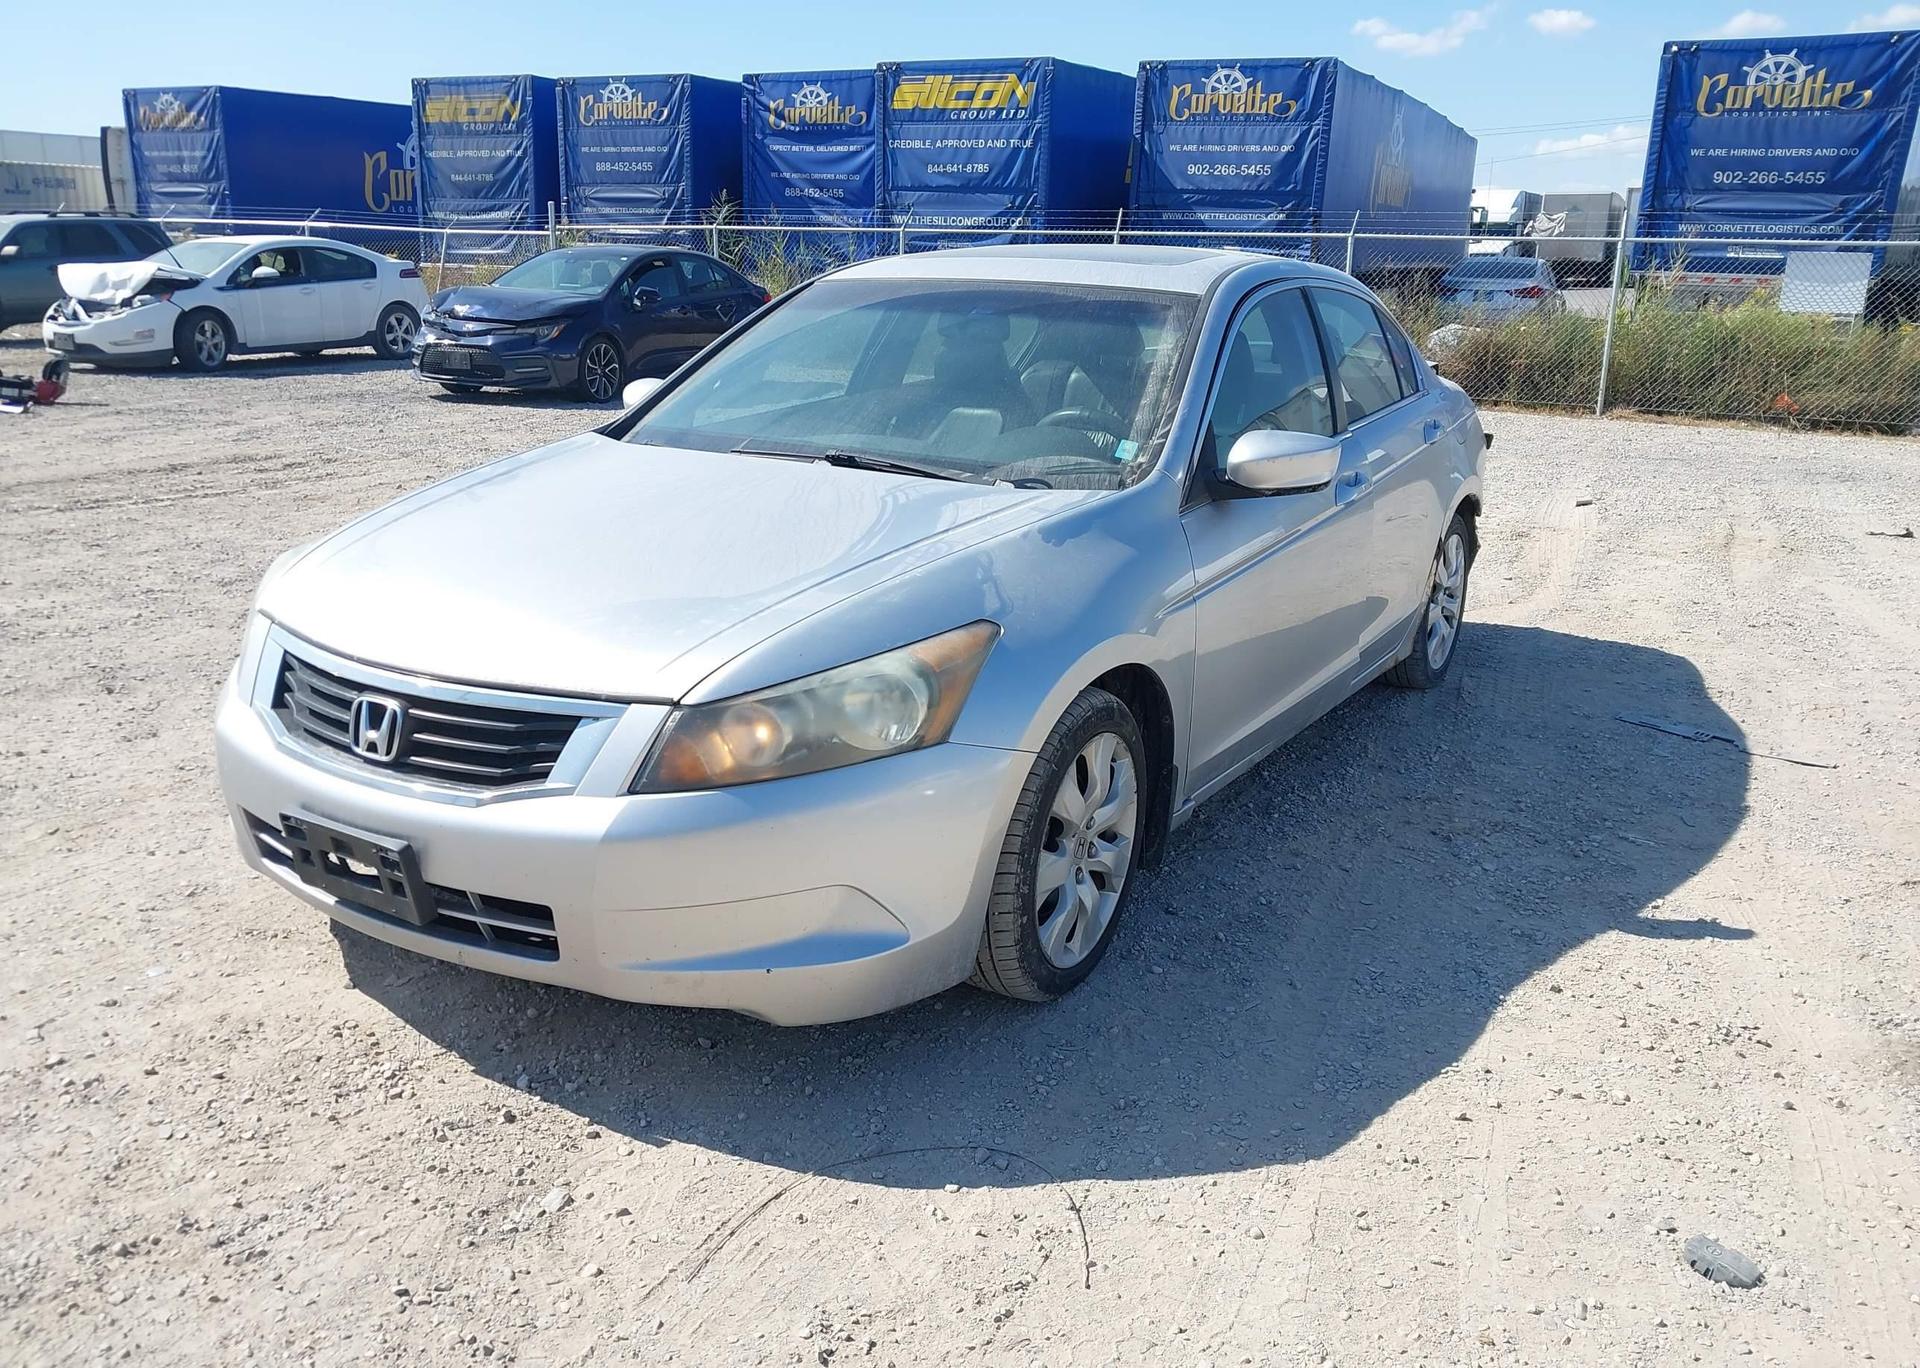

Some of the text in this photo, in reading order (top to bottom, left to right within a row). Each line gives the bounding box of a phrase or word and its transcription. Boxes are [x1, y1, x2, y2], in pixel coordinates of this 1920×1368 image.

[1697, 67, 1873, 118] Corvette
[1168, 80, 1297, 121] Corvette
[579, 91, 669, 126] Corvette
[769, 95, 867, 130] Corvette
[950, 110, 996, 119] GROUP
[463, 122, 495, 131] GROUP
[888, 139, 1034, 150] CREDIBLE, APPROVED AND TRUE
[1168, 144, 1181, 152] WE
[1182, 144, 1198, 152] ARE
[1199, 144, 1226, 153] HIRING
[1227, 144, 1260, 153] DRIVERS
[1261, 144, 1279, 152] AND
[457, 150, 490, 158] APPROVED
[1690, 147, 1859, 157] WE ARE HIRING DRIVERS AND O/O
[595, 161, 653, 172] 888-452-5455
[927, 163, 990, 174] 844-641-8785
[1187, 164, 1271, 176] 902-266-5455
[1713, 171, 1826, 184] 902-266-5455
[784, 188, 844, 198] 888-452-5455
[1162, 212, 1287, 221] WWW.CORVETTELOGISTICS.COM
[1678, 223, 1844, 234] WWW.CORVETTELOGISTICS.COM
